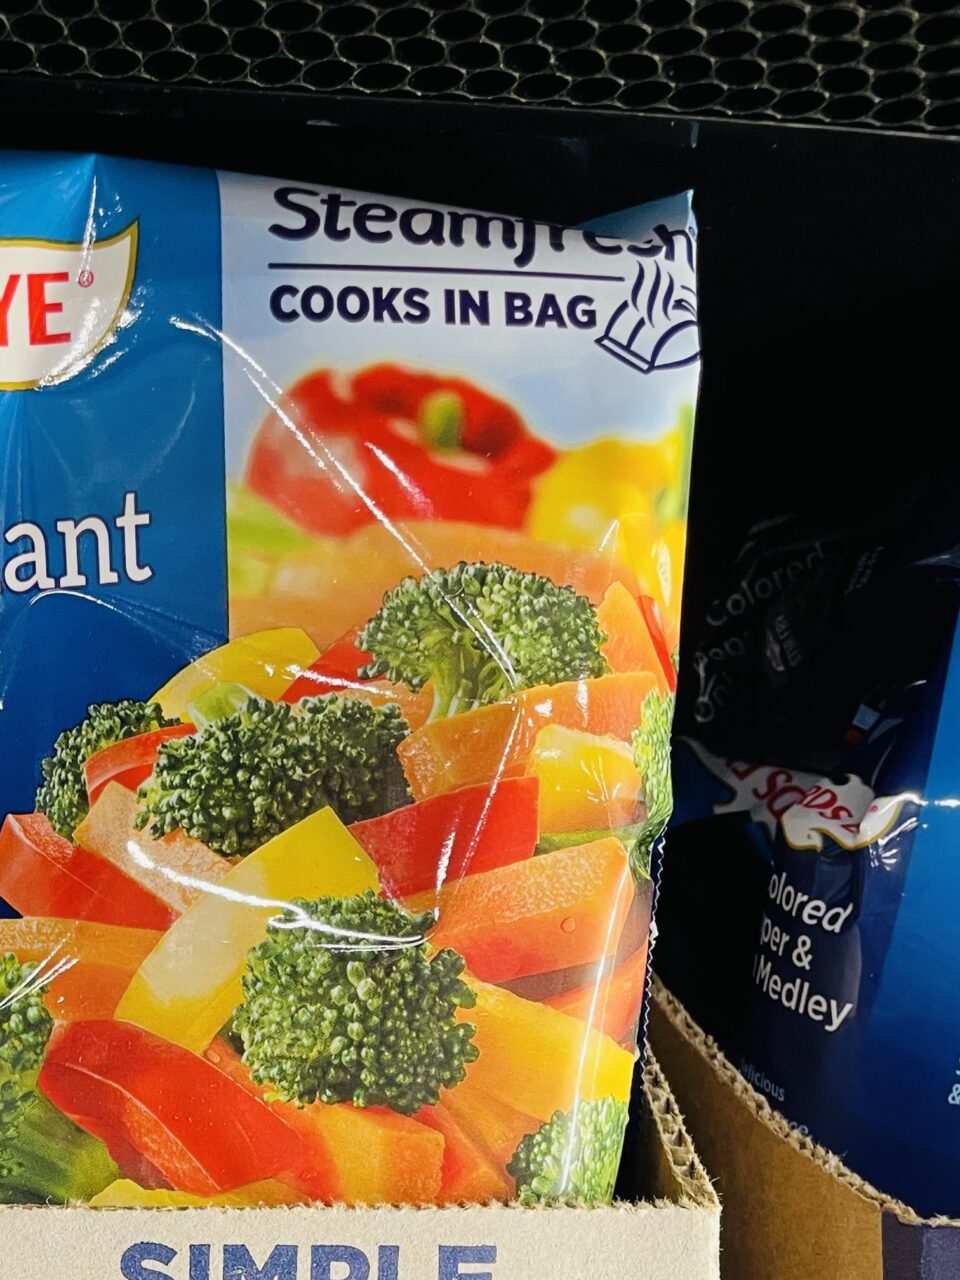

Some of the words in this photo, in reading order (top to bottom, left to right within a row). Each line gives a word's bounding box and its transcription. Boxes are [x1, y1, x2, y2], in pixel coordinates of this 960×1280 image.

[269, 284, 430, 323] COOKS
[444, 290, 490, 326] IN
[504, 292, 597, 330] BAG
[792, 935, 813, 971] &
[756, 953, 854, 1033] Medley
